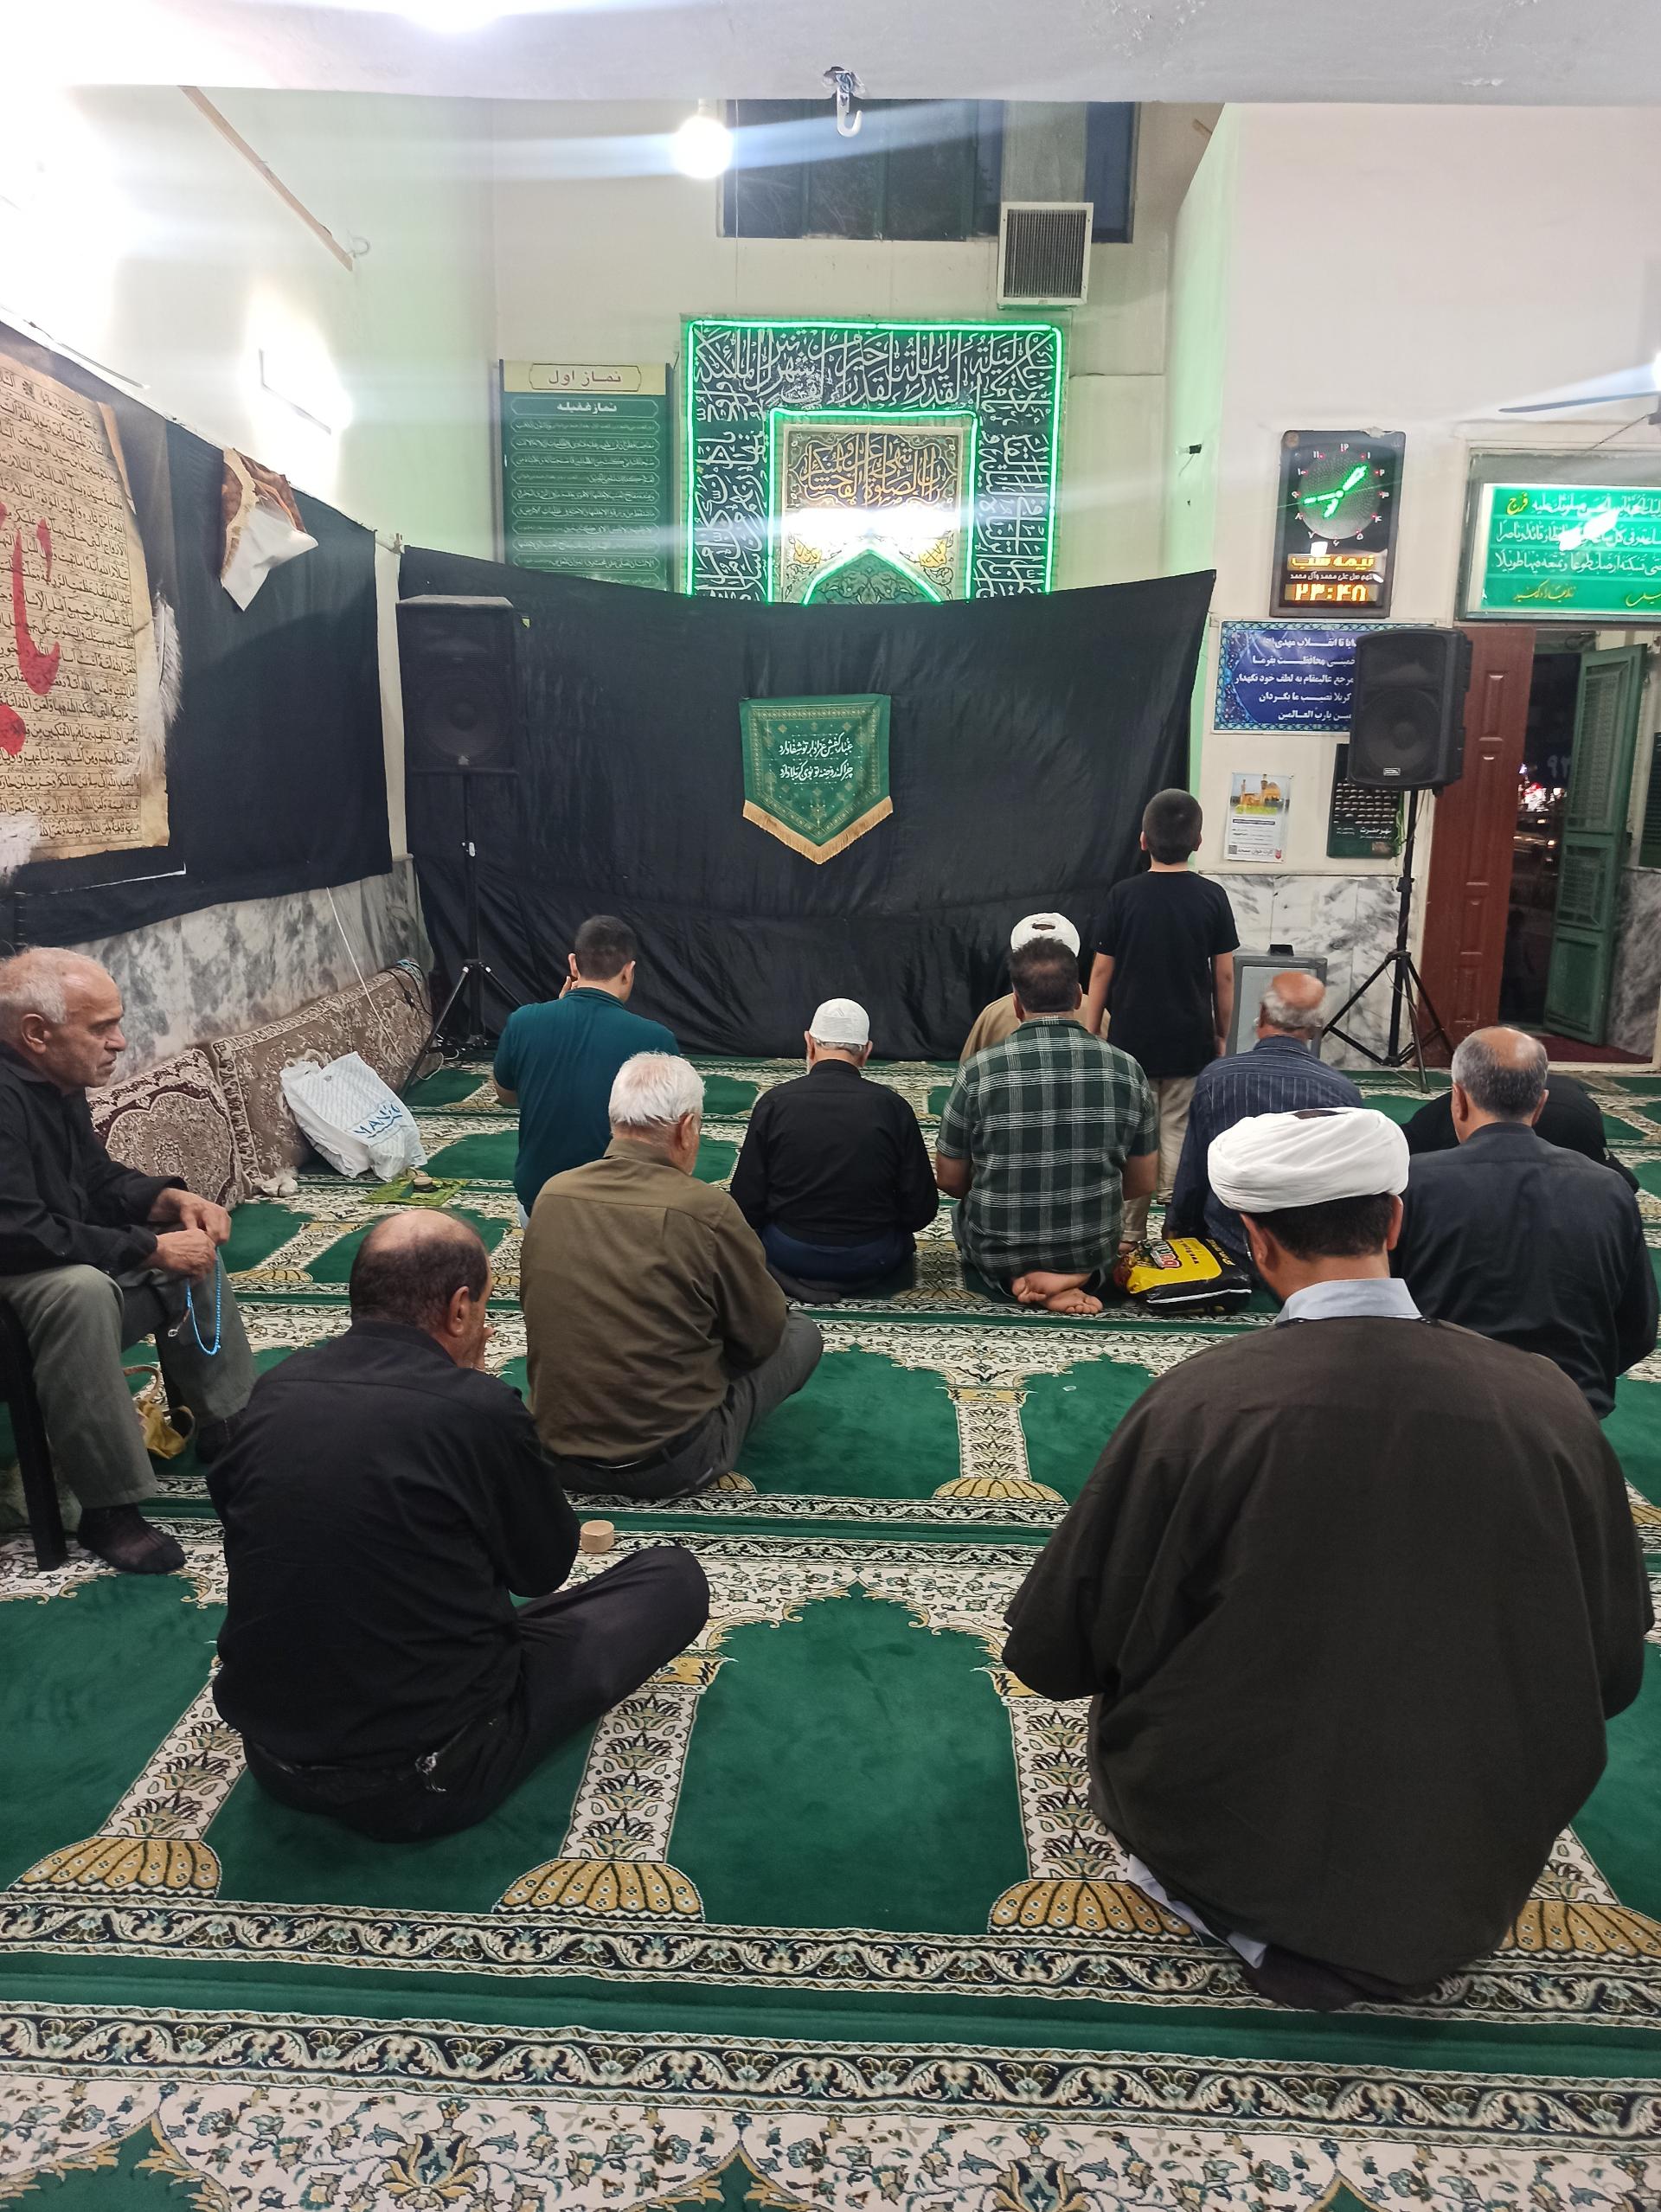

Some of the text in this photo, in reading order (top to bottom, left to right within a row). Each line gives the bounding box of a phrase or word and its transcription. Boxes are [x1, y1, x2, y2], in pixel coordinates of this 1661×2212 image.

[548, 369, 621, 386] نماز اول
[592, 402, 618, 414] نماز
[1506, 491, 1529, 515] فرج
[1333, 555, 1375, 570] نیمه
[1274, 638, 1296, 649] مهدی
[1297, 638, 1337, 647] انقلاب
[1253, 655, 1356, 667] خمینی محافظت بفرما
[1235, 674, 1258, 683] نگهدار
[1260, 674, 1274, 684] خود
[1333, 676, 1354, 685] مرجع
[1259, 692, 1291, 702] بگردان
[1301, 692, 1332, 703] نصیب
[1334, 692, 1351, 703] کربلا
[1279, 710, 1313, 720] العالمین
